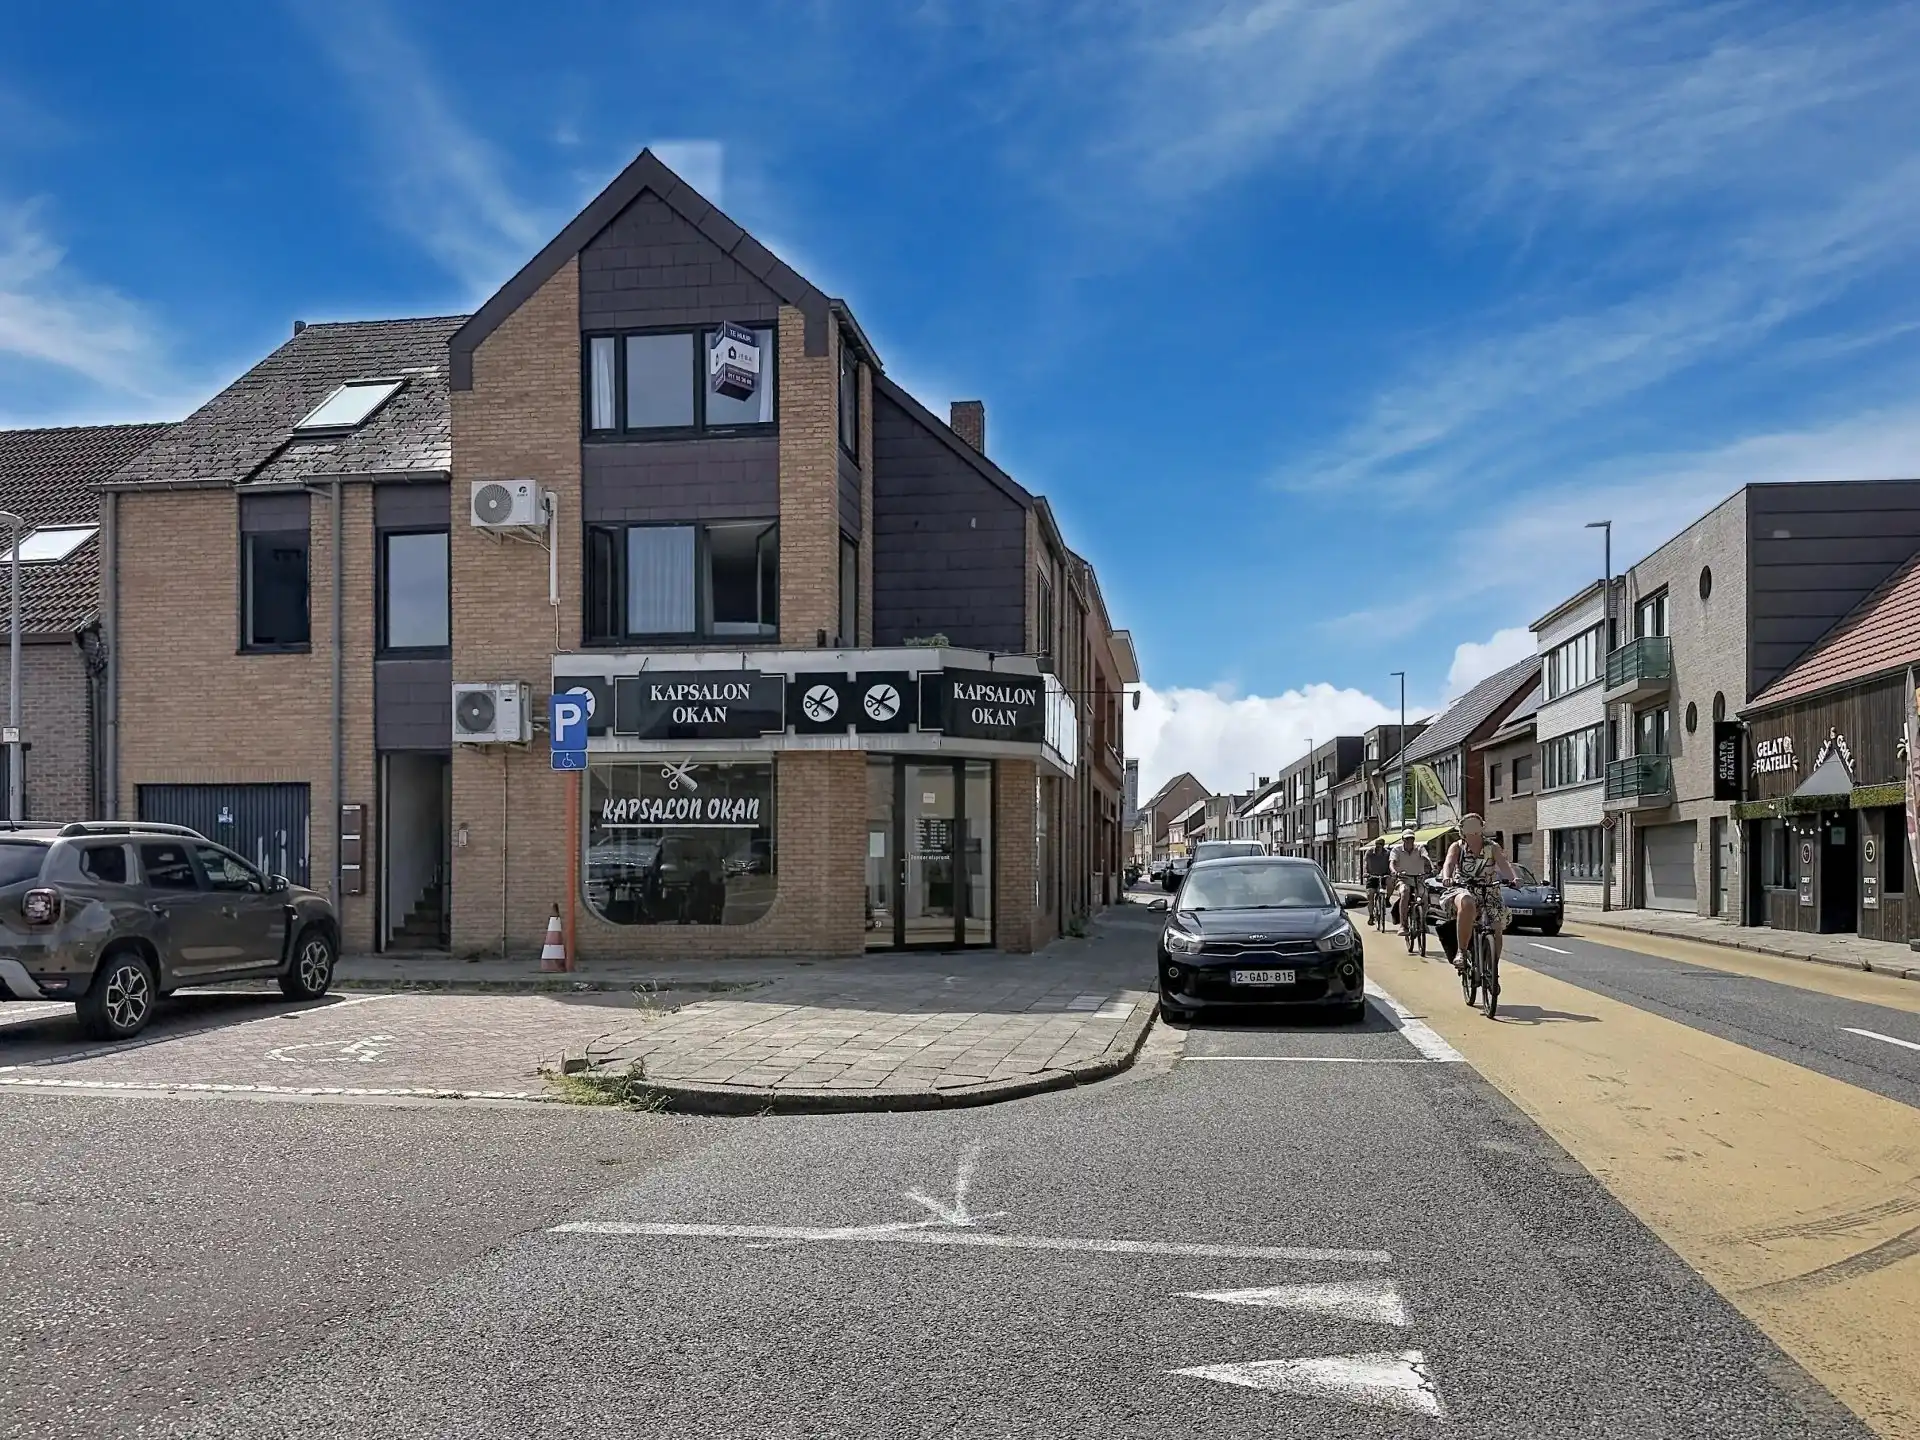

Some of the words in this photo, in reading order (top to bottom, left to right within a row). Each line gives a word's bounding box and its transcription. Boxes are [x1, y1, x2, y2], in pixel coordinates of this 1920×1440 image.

[651, 683, 750, 700] KAPSALON
[953, 682, 1036, 706] KAPSALON
[555, 703, 581, 742] P
[672, 706, 727, 723] OKAN
[971, 707, 1017, 726] OKAN
[1727, 742, 1735, 780] FRATELLI
[1756, 753, 1791, 773] FRATELLI
[1836, 734, 1855, 773] GRILL
[602, 798, 702, 823] KAPSALON
[707, 798, 760, 823] OKAN
[1237, 971, 1294, 982] 2-GAD-815
